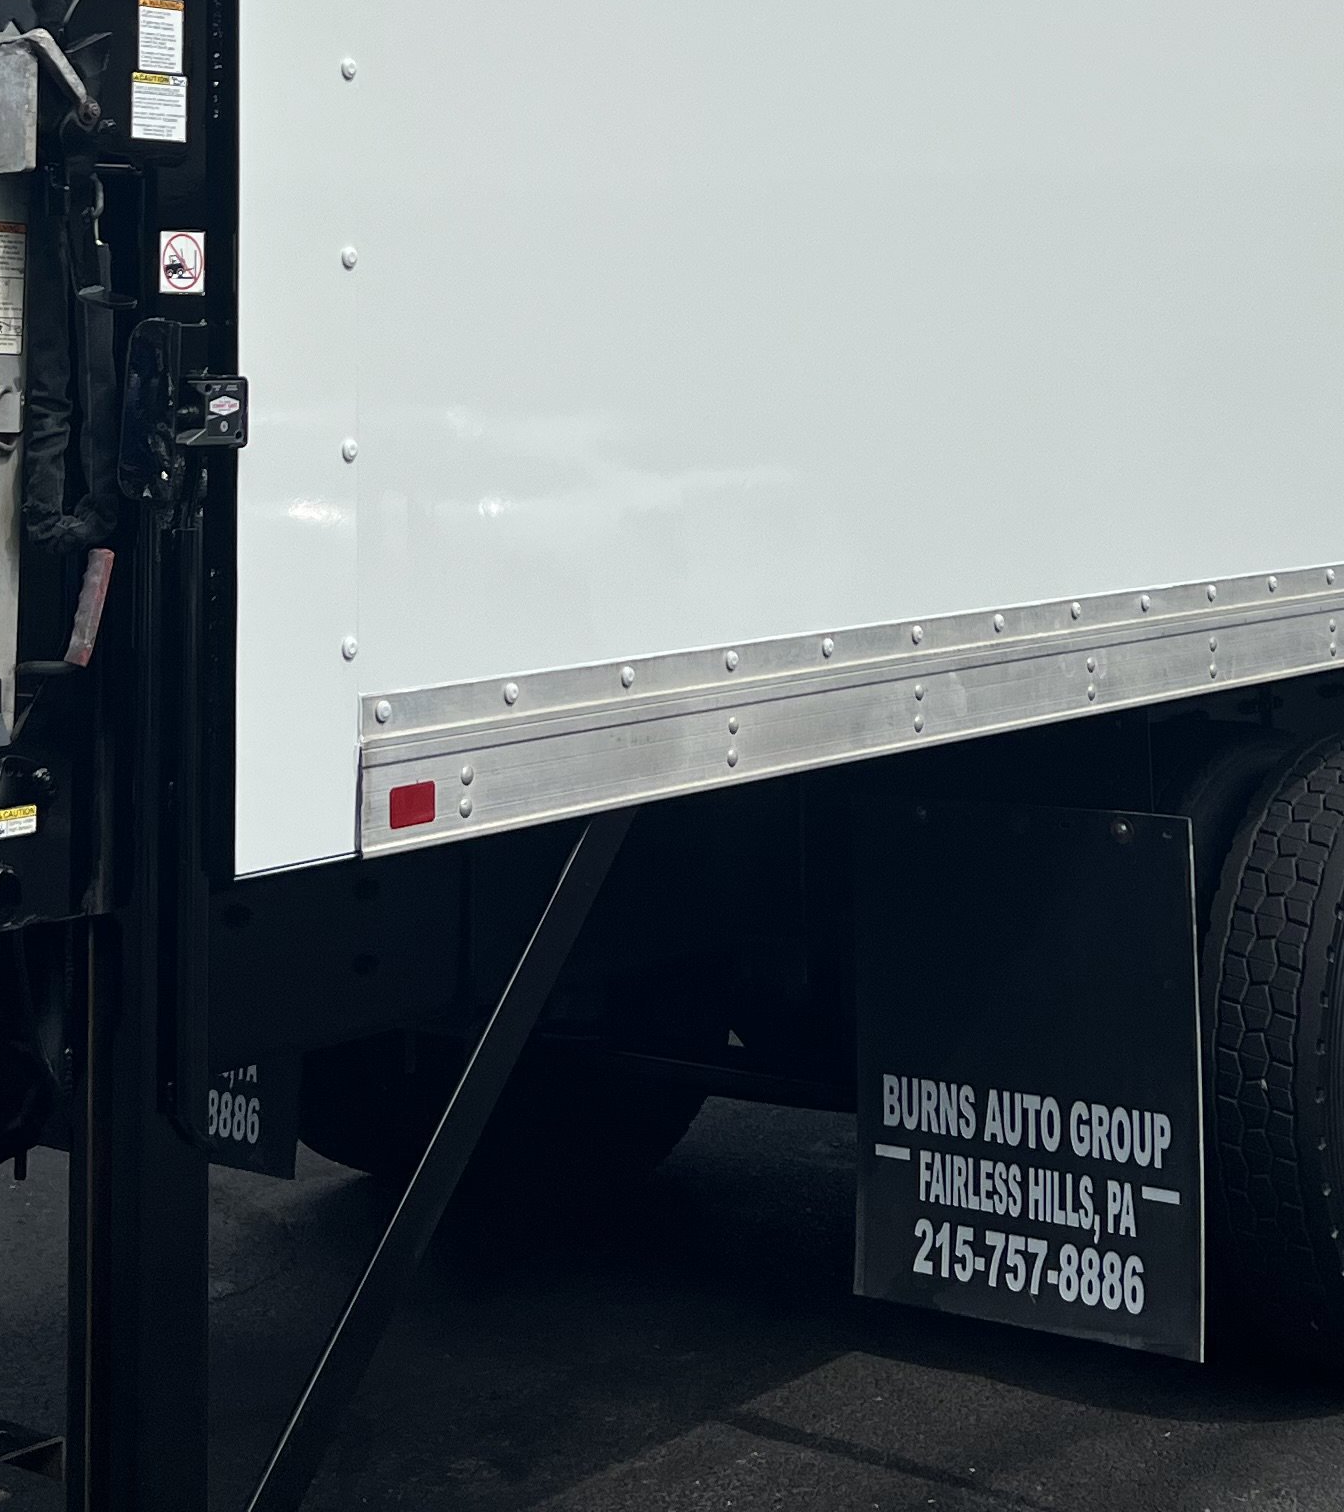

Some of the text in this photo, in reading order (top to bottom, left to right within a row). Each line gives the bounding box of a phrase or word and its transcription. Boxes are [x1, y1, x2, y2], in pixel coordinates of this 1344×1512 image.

[3, 807, 35, 819] CAUTION
[882, 1073, 1172, 1169] BURNS AUTO GROUP
[918, 1149, 1137, 1245] FAIRLESS HILLS, PA
[912, 1217, 1145, 1316] 215-757-8886
